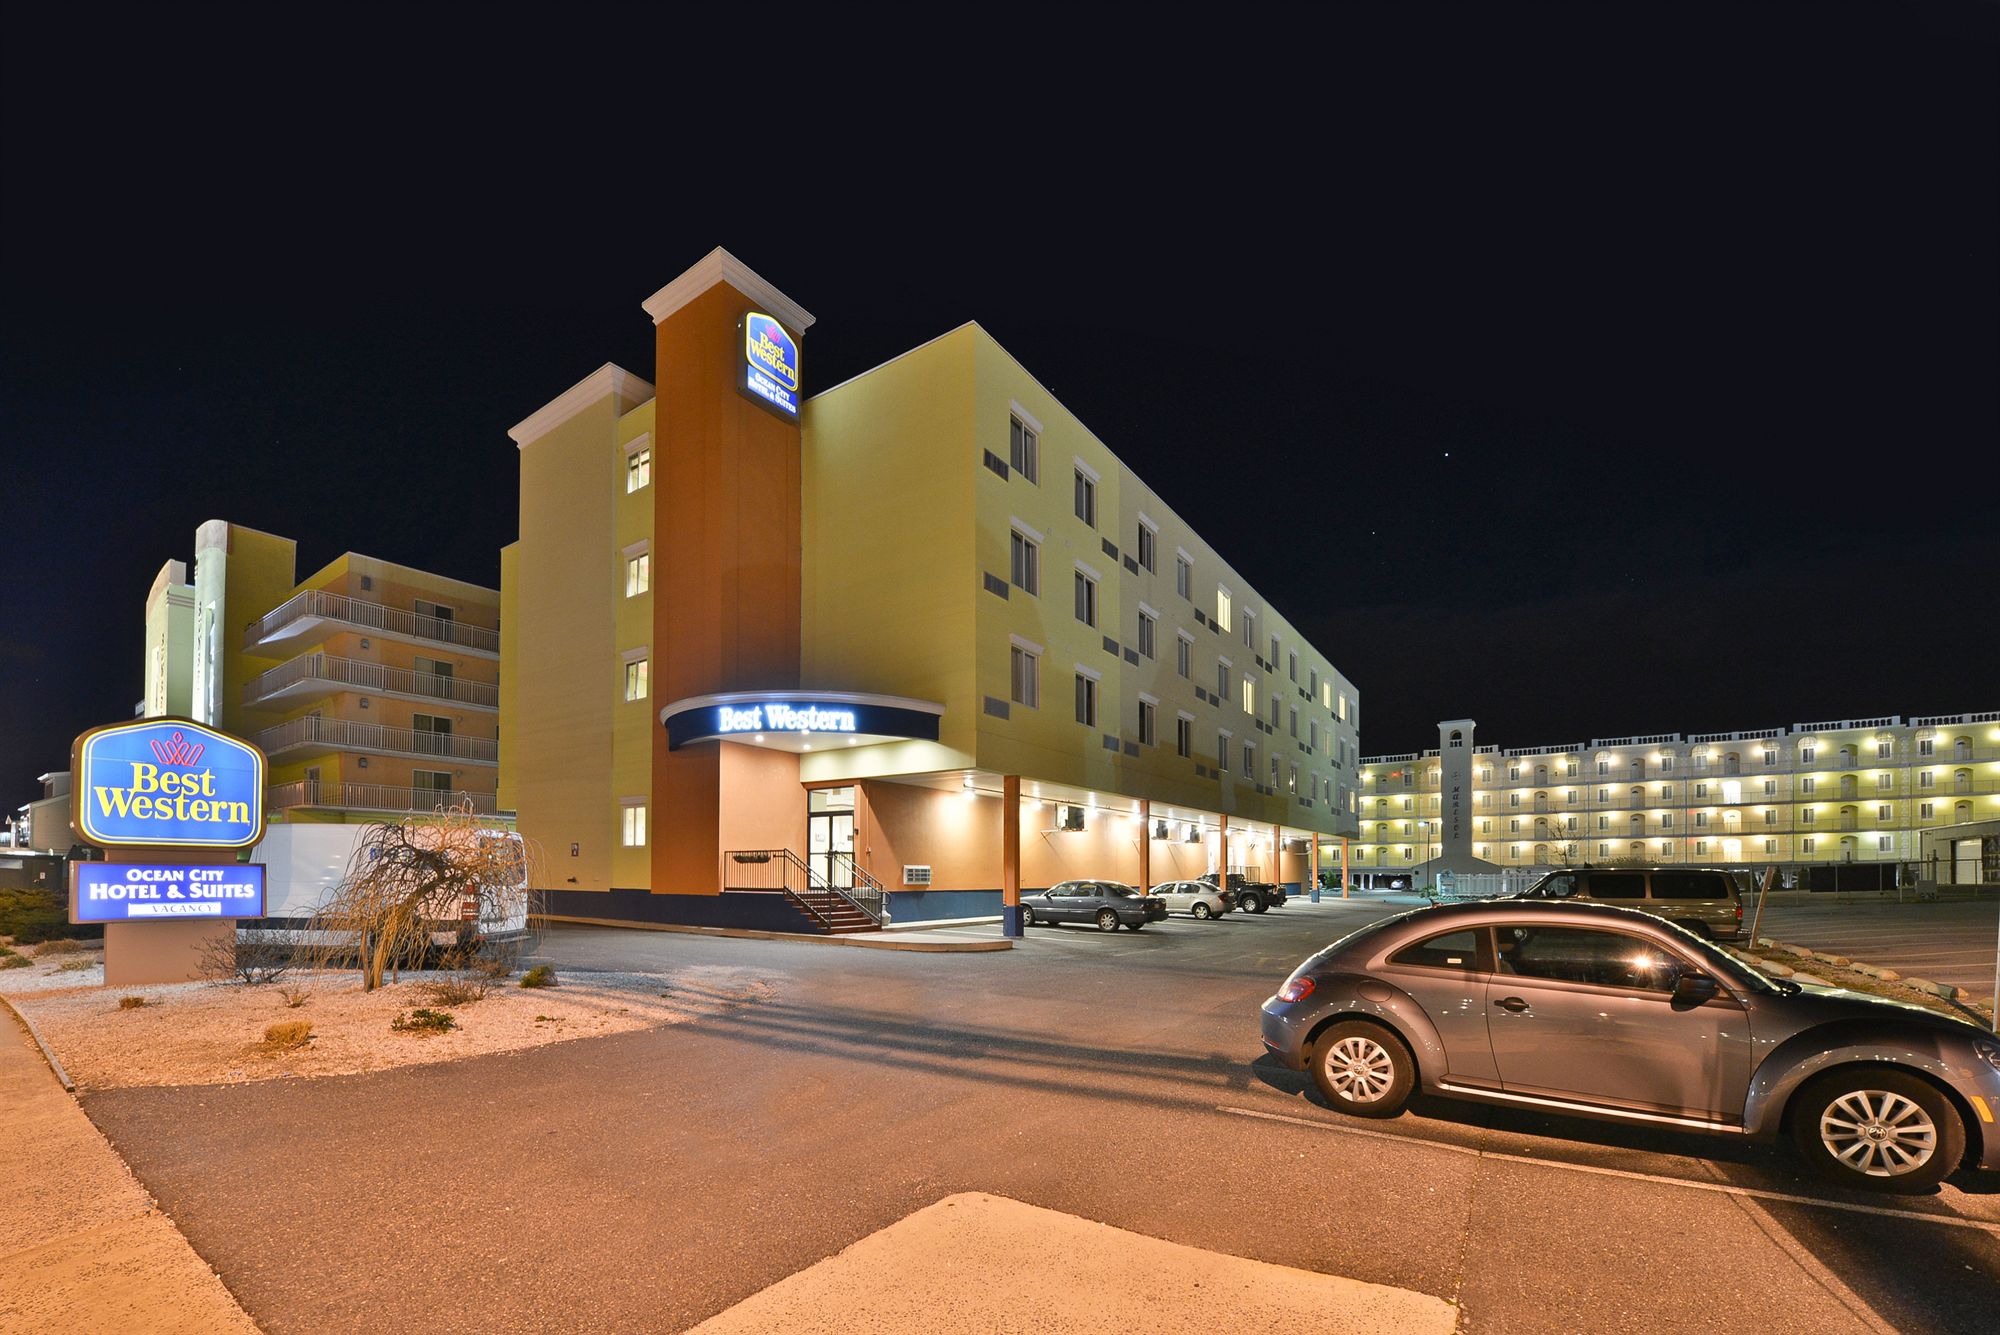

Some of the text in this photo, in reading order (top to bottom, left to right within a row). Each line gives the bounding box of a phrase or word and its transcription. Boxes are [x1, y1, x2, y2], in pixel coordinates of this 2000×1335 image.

[750, 337, 795, 381] Western
[760, 331, 785, 361] Best
[769, 390, 775, 401] &
[719, 704, 856, 732] Best Western
[130, 762, 216, 797] Best
[93, 786, 250, 824] Western
[166, 884, 186, 899] &
[152, 905, 213, 913] VACANCY
